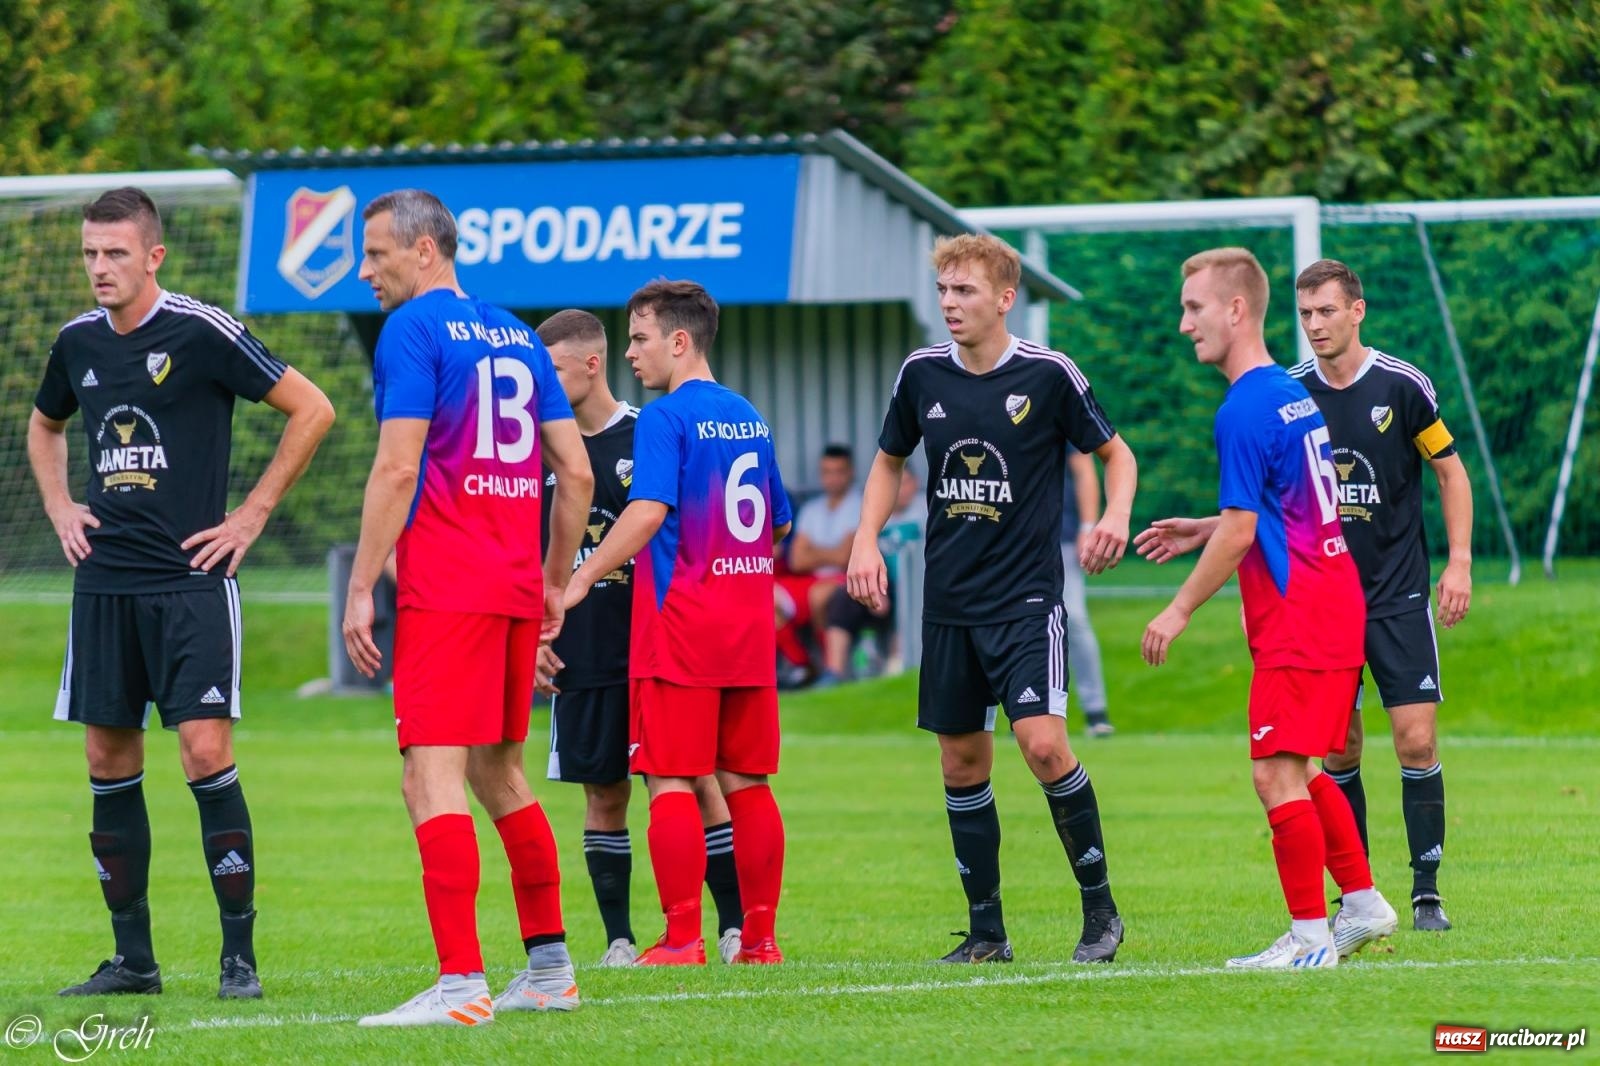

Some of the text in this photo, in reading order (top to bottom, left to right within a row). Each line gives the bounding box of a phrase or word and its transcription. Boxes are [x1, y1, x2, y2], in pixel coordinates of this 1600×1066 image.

[454, 202, 744, 264] SPODARZE
[446, 321, 471, 341] KS
[473, 355, 535, 464] 13
[696, 421, 717, 440] KS
[96, 445, 168, 472] JANETA
[725, 452, 766, 543] 6
[936, 478, 1013, 503] JANETA
[1337, 484, 1381, 504] NETA
[213, 863, 250, 876] adidas
